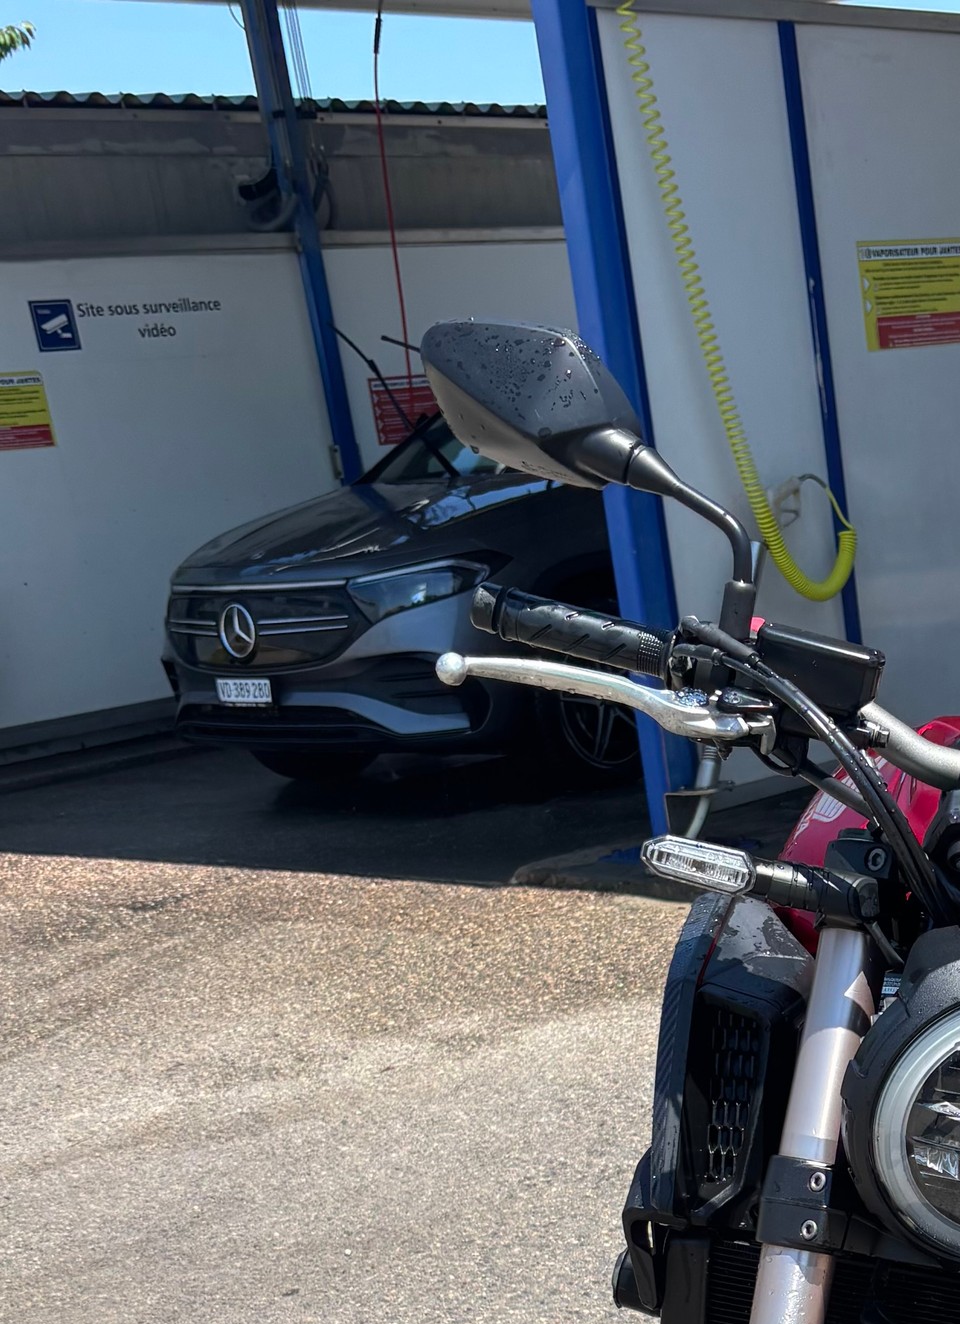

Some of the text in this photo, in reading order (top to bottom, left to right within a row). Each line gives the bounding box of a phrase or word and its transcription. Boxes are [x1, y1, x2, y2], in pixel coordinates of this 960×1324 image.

[76, 298, 221, 317] Site sous surveillance
[138, 323, 176, 338] vidéo
